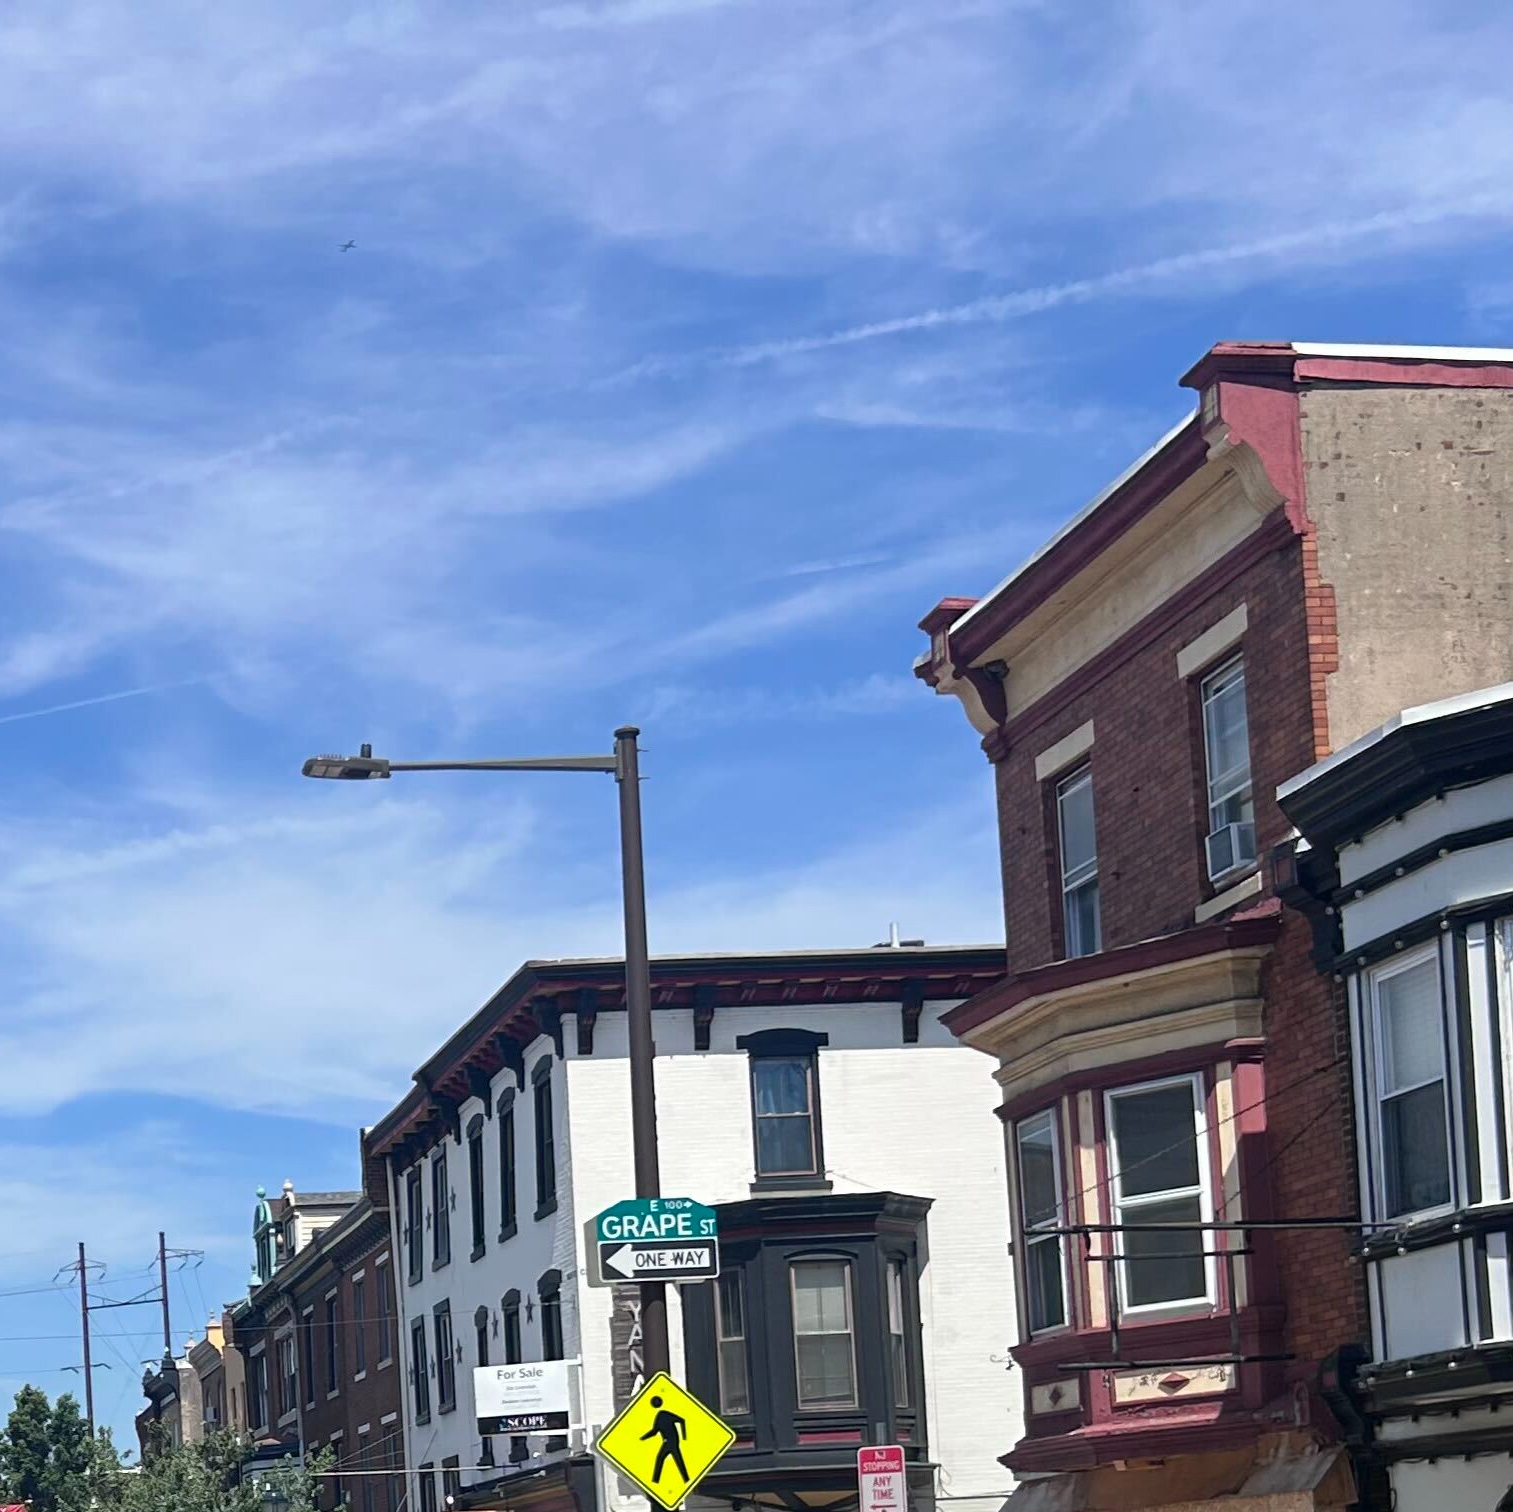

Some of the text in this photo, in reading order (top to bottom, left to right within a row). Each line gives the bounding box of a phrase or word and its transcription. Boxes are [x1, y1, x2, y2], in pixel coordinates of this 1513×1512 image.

[650, 1200, 682, 1211] E 100
[602, 1213, 715, 1238] GRAPE ST
[636, 1251, 704, 1267] ONE WAY
[497, 1366, 543, 1380] For Sale
[863, 1460, 901, 1472] STOPPING
[873, 1476, 891, 1487] ANY
[872, 1488, 894, 1500] TIME
